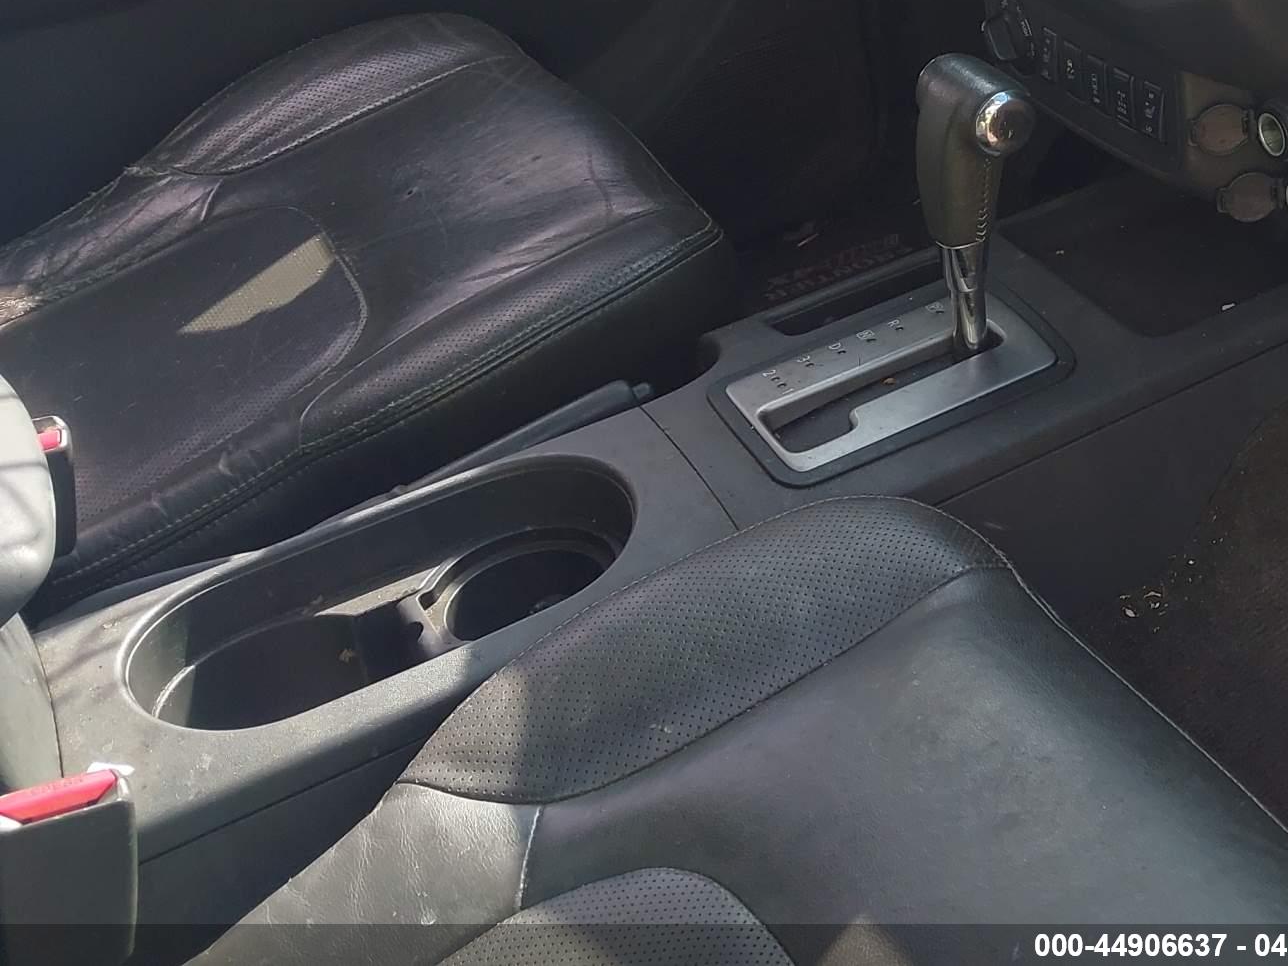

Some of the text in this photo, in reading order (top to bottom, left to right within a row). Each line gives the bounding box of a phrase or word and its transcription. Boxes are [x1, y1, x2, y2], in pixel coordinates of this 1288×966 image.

[888, 318, 901, 328] R
[828, 342, 841, 350] D
[763, 369, 777, 378] 2
